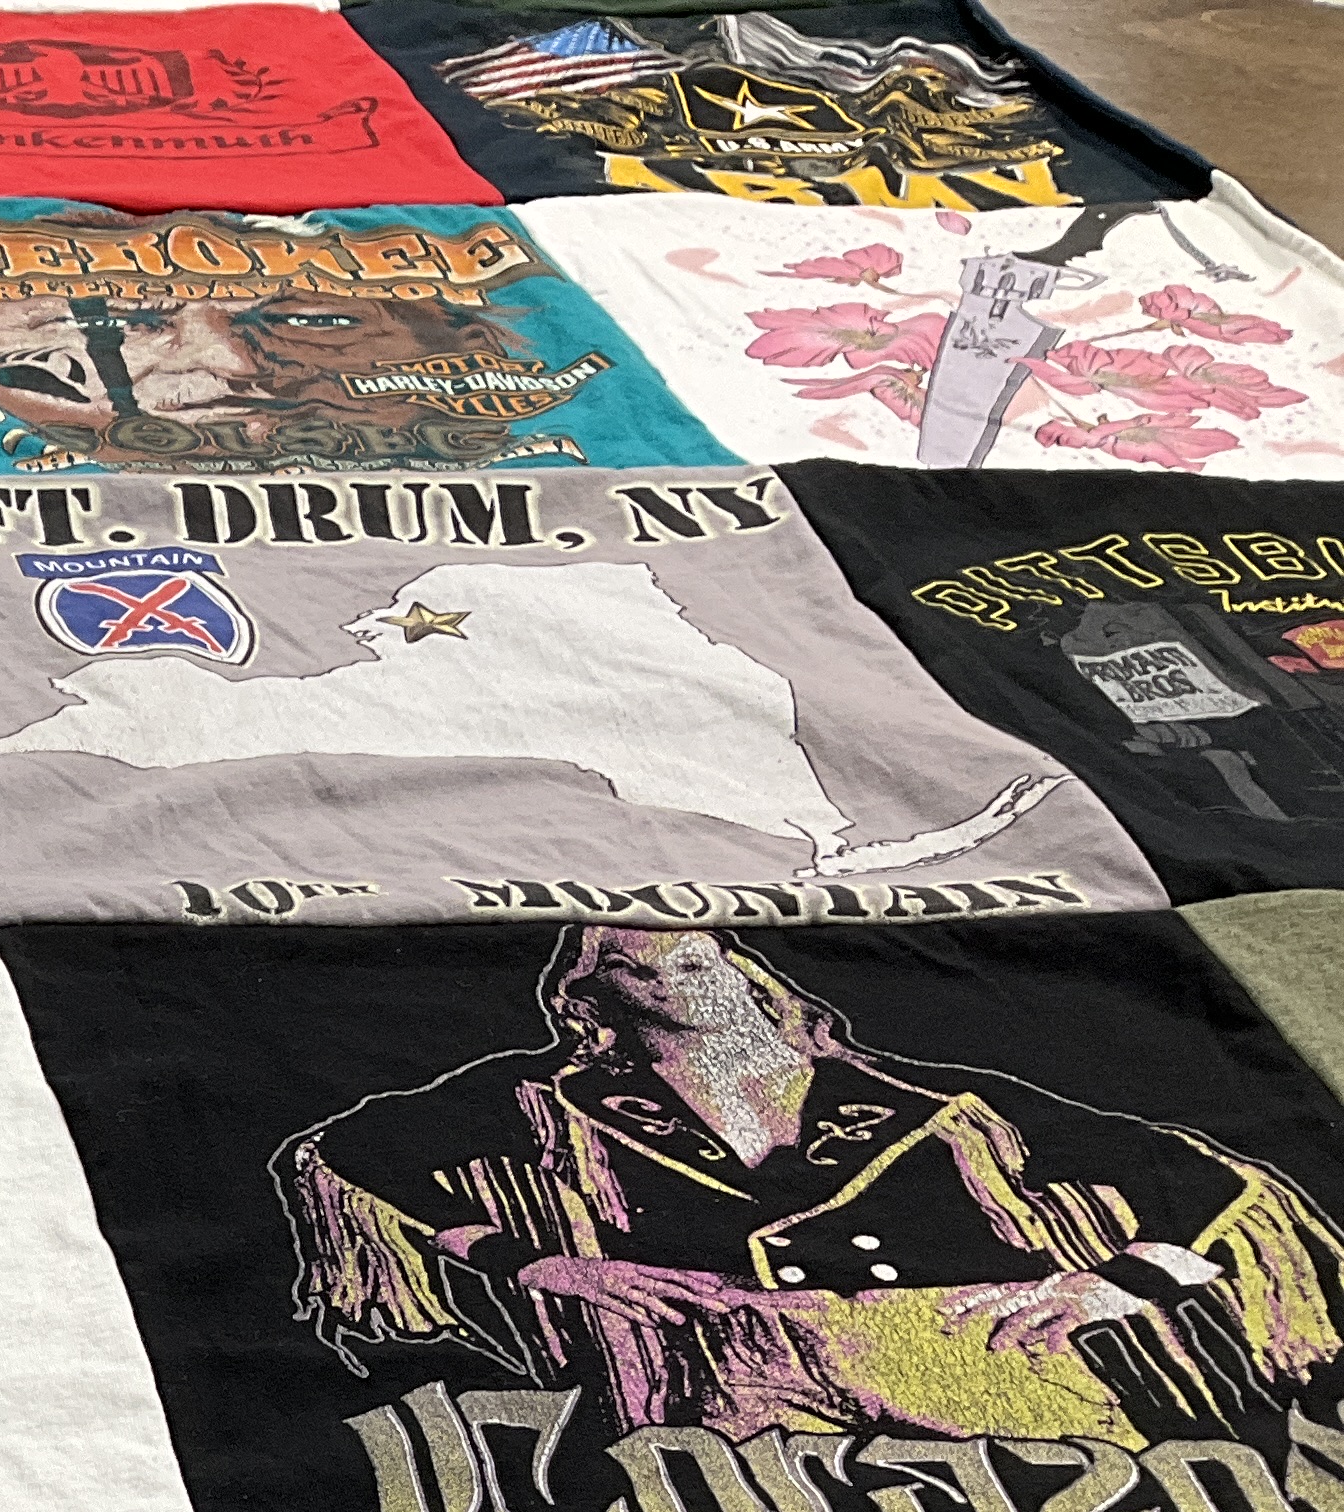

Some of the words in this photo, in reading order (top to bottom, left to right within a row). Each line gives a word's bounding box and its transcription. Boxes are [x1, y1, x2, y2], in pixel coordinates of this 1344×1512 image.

[777, 138, 864, 153] ARMY
[354, 361, 598, 395] HARLEY-DAVIDSON
[172, 481, 587, 551] DRUM,
[615, 480, 782, 543] NY
[31, 552, 205, 576] MOUNTAIN
[447, 874, 1088, 922] MOUNTAIN
